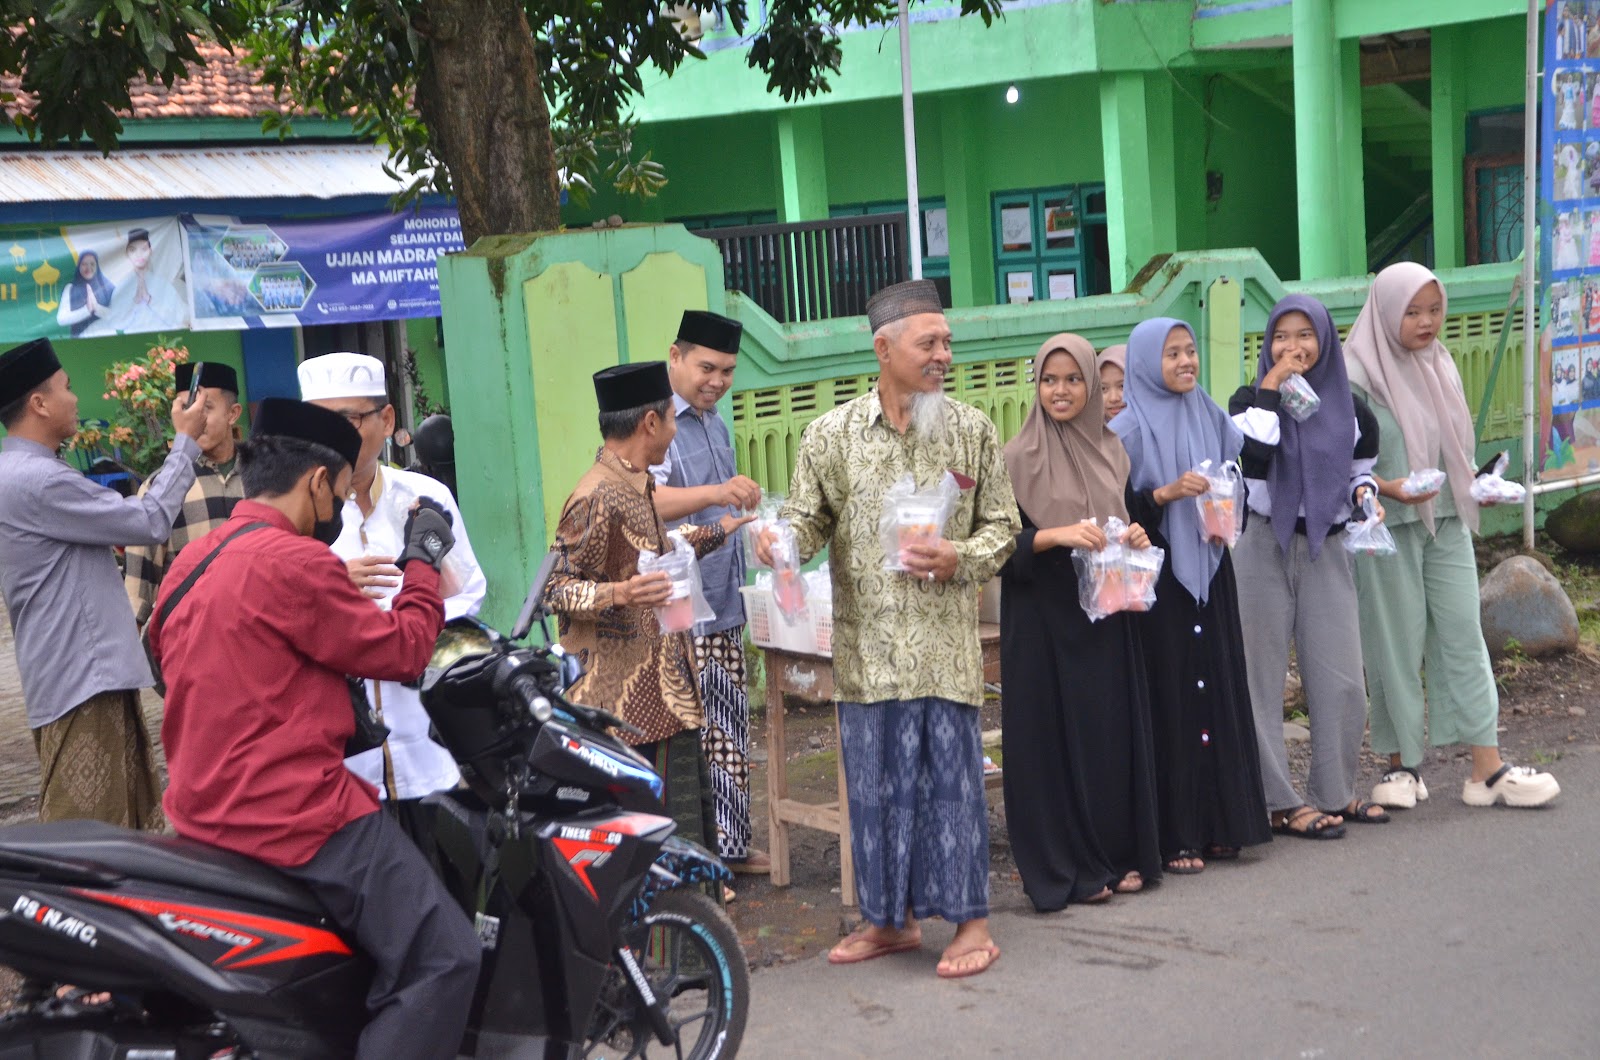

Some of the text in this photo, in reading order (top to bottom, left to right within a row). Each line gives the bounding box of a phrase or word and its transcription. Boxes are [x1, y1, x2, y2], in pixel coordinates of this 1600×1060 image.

[404, 217, 460, 230] MOHON D
[390, 231, 441, 246] SELAMAT
[325, 245, 466, 268] UJIAN MADRAS
[351, 271, 377, 286] MA
